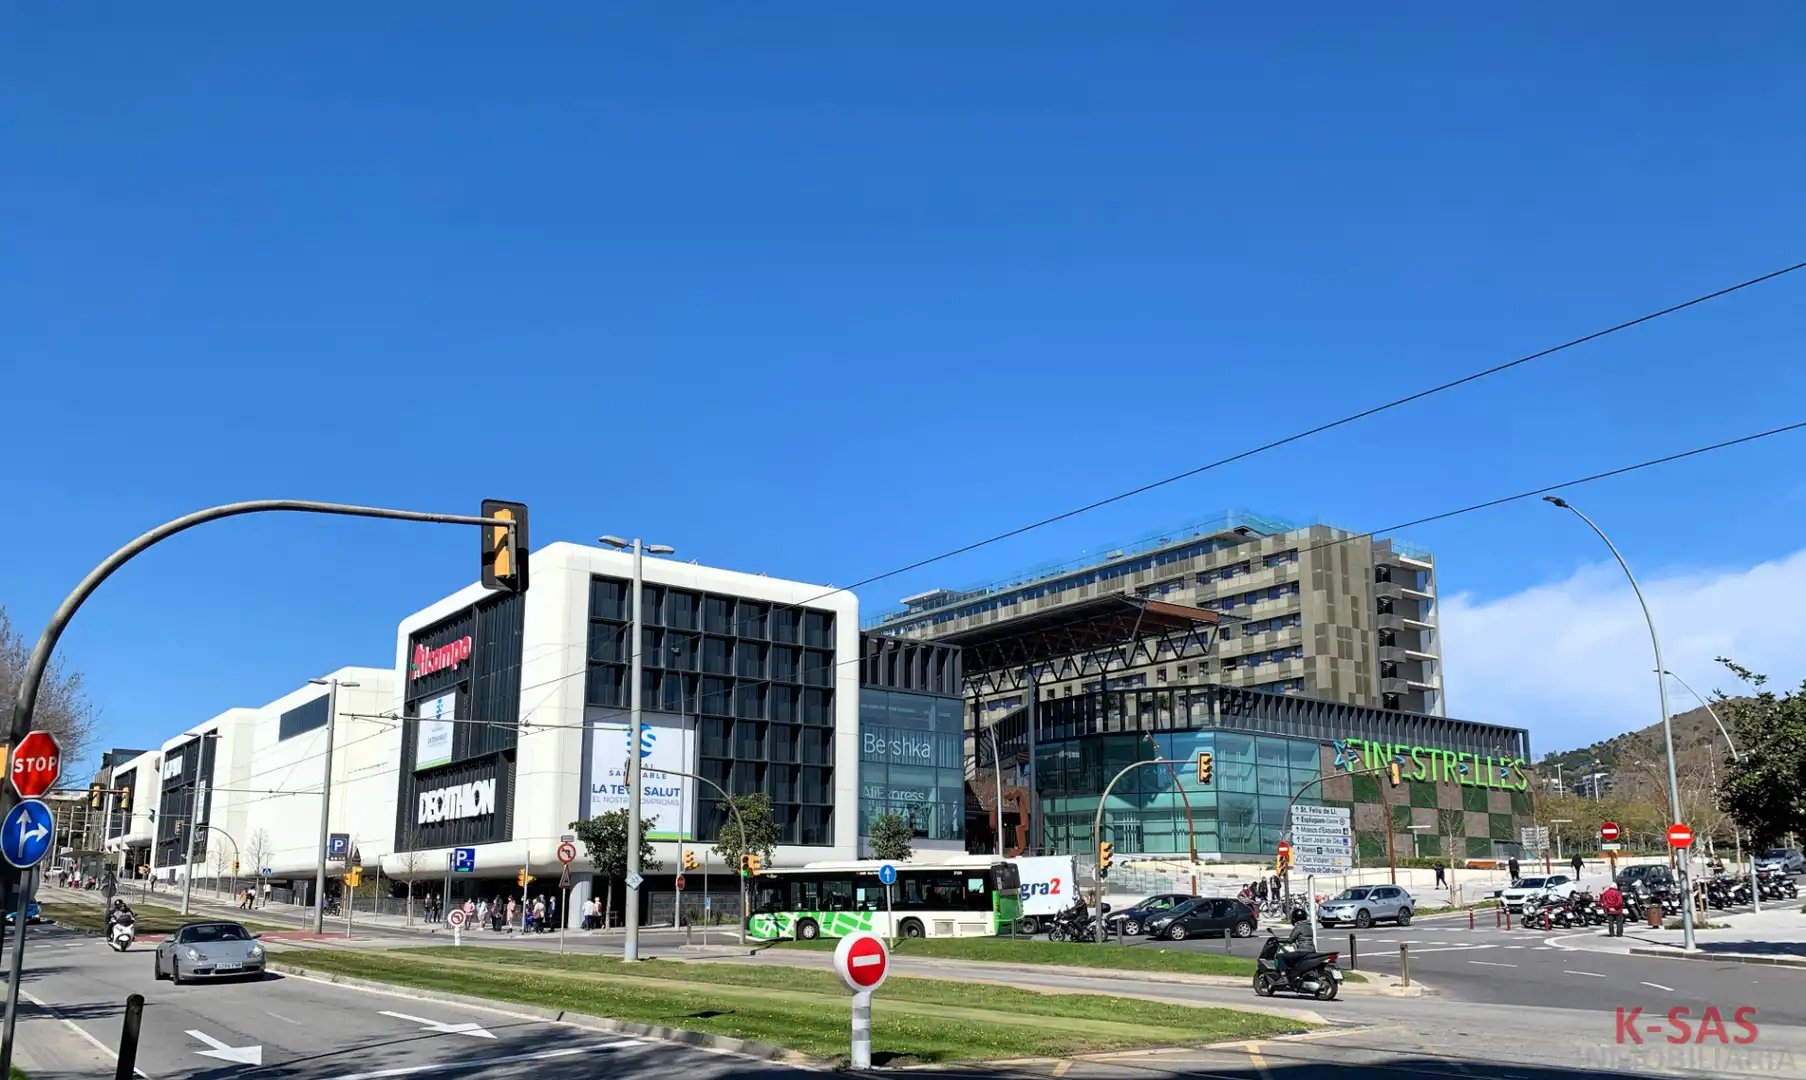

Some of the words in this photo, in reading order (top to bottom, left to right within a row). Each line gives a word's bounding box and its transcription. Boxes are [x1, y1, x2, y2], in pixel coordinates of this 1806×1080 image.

[411, 636, 472, 680] Alcampo
[14, 756, 57, 773] STOP
[592, 783, 608, 794] LA
[610, 784, 631, 795] TEV
[643, 786, 681, 797] SALUT
[417, 778, 496, 824] DECATHLON
[333, 839, 344, 852] P
[456, 850, 468, 867] P
